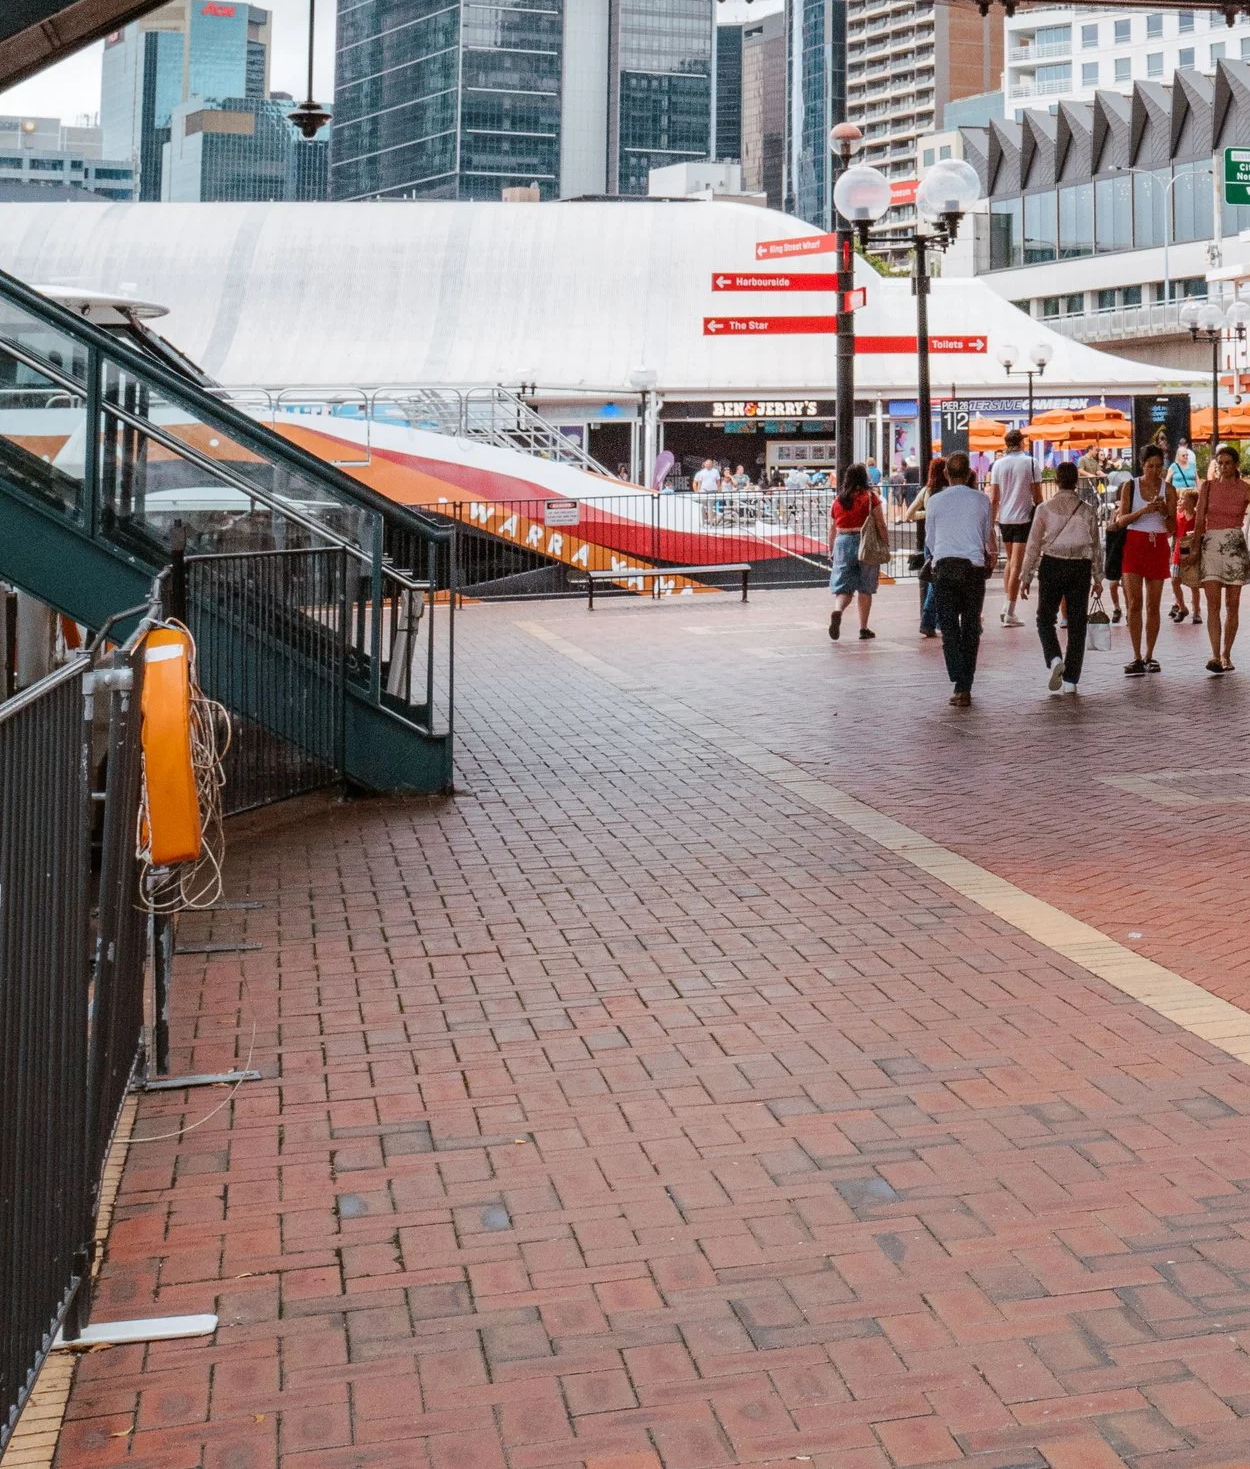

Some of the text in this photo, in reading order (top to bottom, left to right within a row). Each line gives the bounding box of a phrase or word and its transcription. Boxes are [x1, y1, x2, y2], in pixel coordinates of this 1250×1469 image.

[769, 240, 820, 254] King Street Wharf
[736, 277, 790, 287] Harbourside
[729, 321, 769, 330] The Star
[932, 340, 964, 349] Toilets
[713, 402, 744, 416] BEN
[756, 400, 817, 416] JERRY'S
[941, 401, 969, 410] PIER 26
